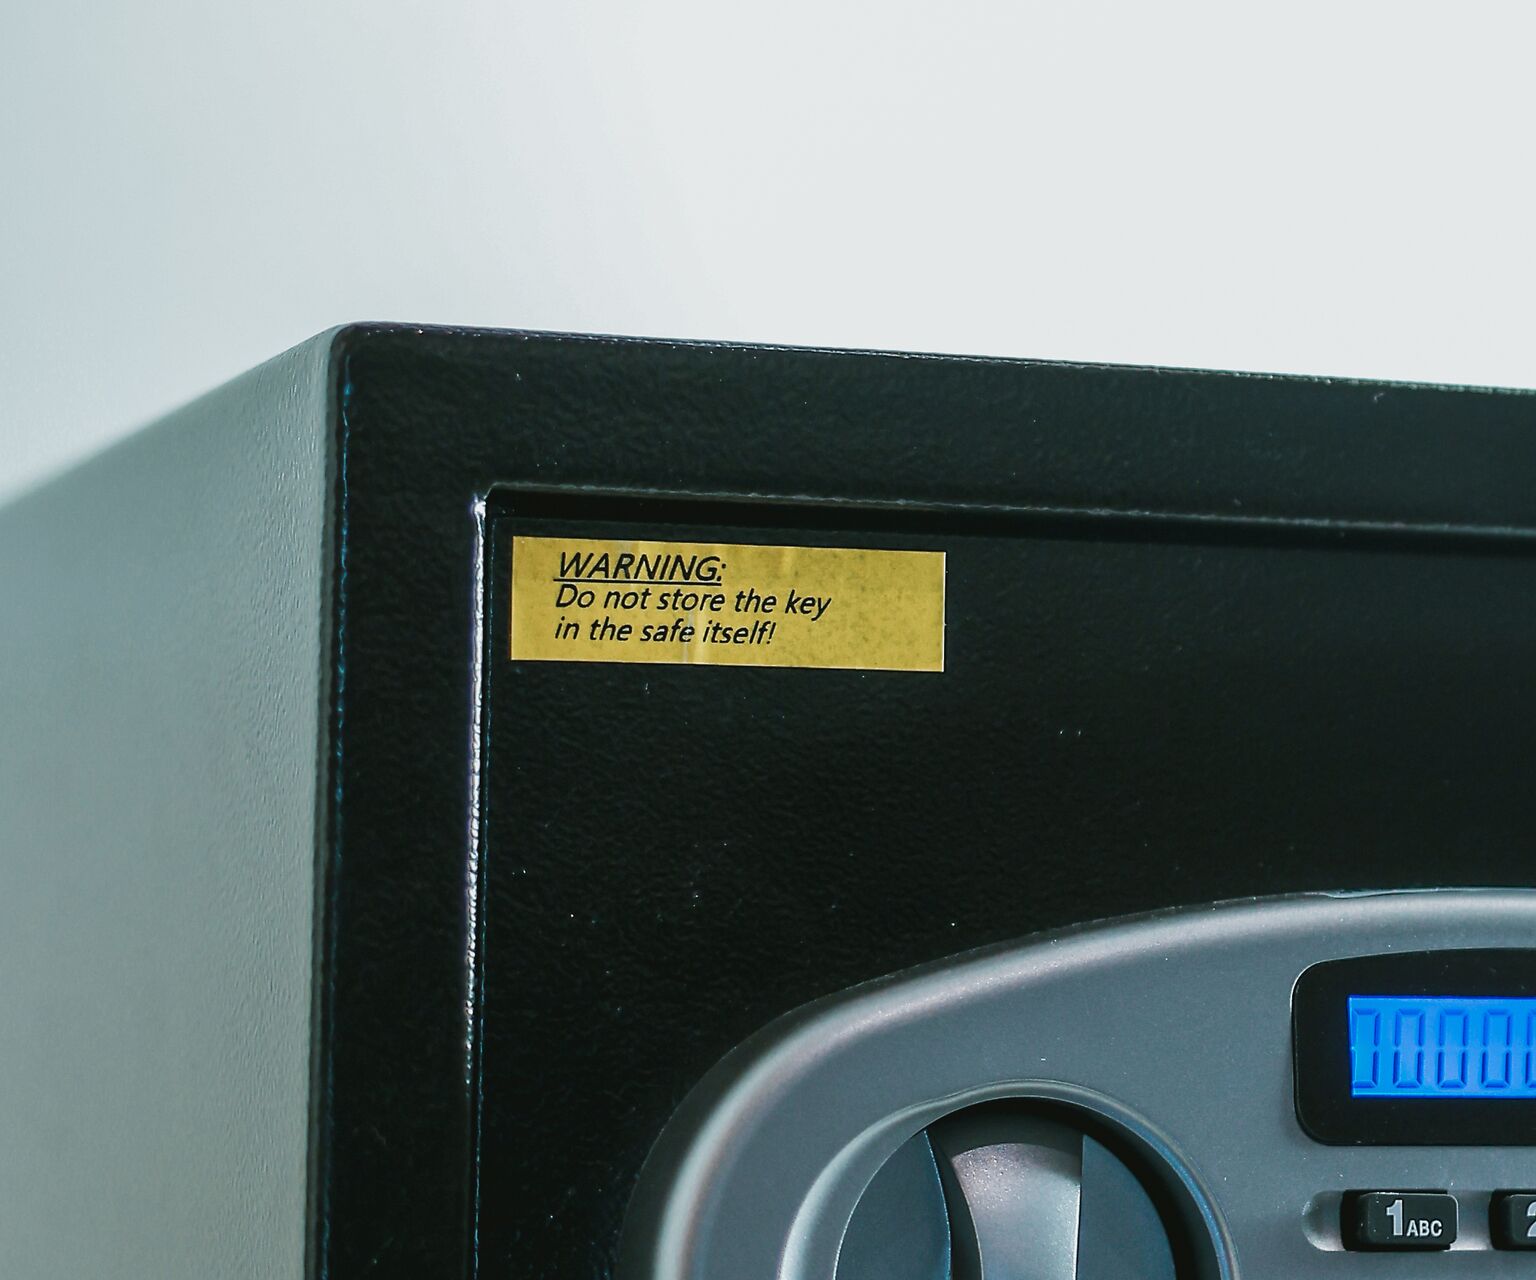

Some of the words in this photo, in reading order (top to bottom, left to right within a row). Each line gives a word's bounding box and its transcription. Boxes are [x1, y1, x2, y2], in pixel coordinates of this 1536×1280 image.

[558, 551, 727, 582] WARNING:
[555, 584, 595, 609] Do
[603, 586, 652, 610] not
[656, 589, 726, 612] store
[734, 589, 777, 614] the
[784, 590, 832, 621] key
[554, 616, 579, 640] in
[589, 617, 633, 642] the
[640, 618, 696, 643] safe
[702, 619, 777, 645] itself!
